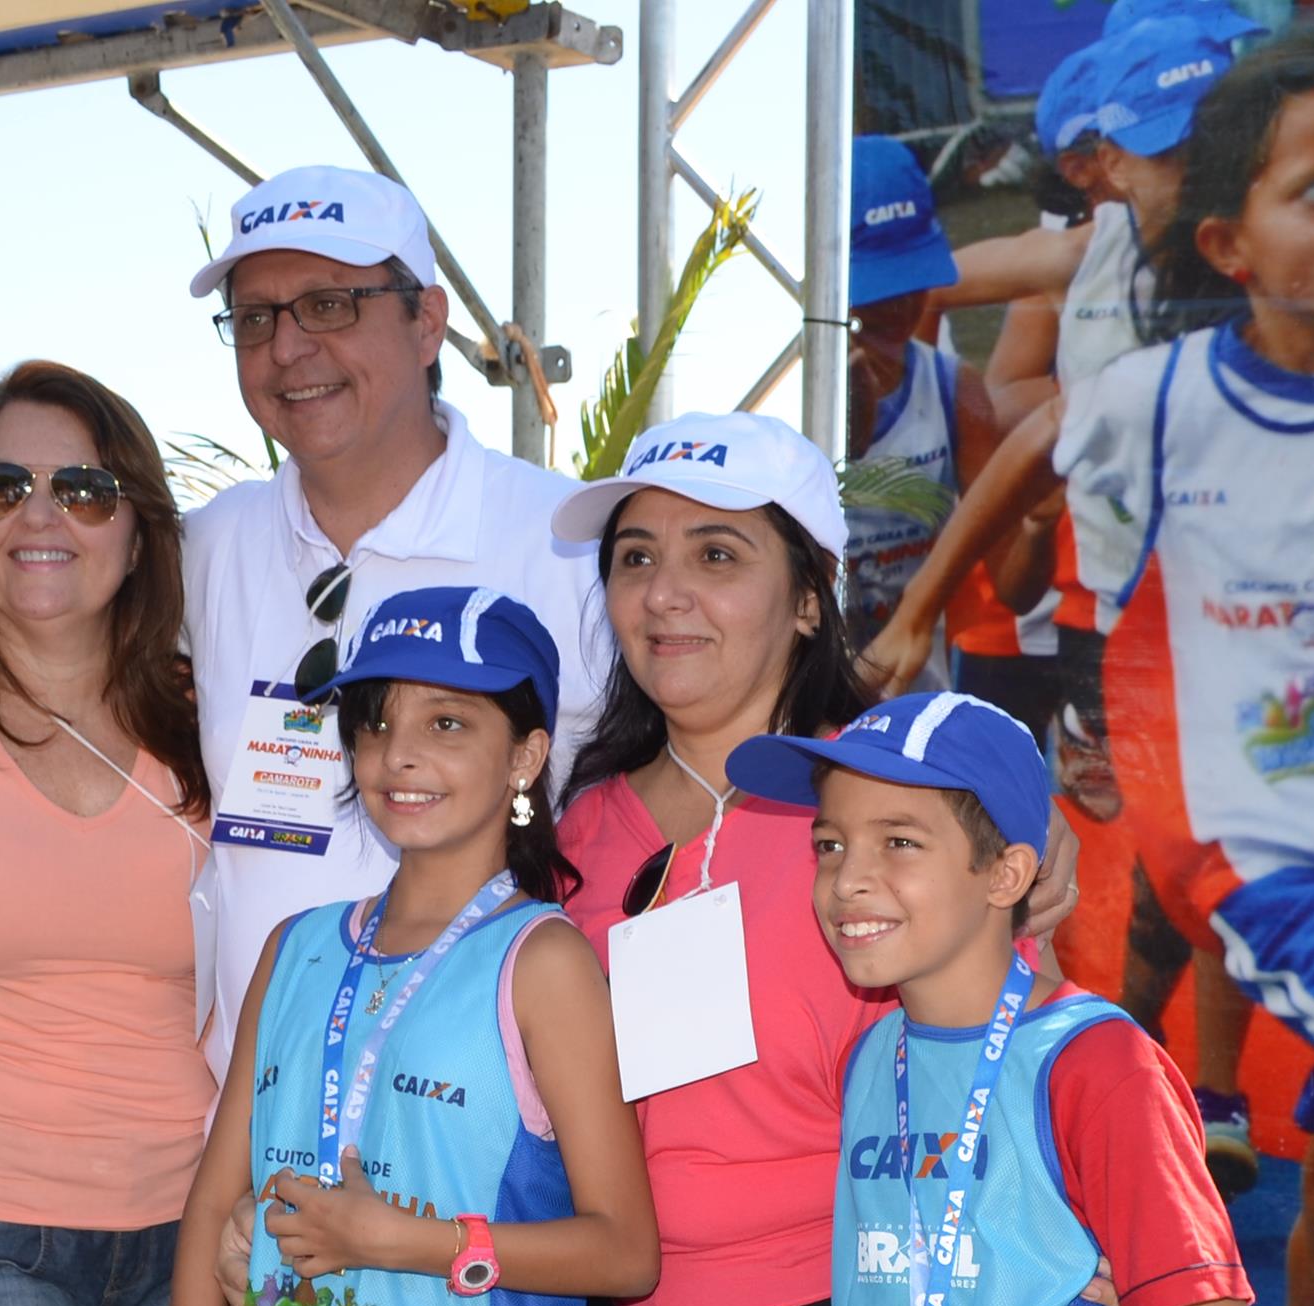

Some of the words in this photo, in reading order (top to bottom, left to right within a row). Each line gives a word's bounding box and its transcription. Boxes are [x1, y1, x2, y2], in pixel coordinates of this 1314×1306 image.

[240, 200, 345, 234] CAIXA
[865, 201, 916, 226] CAIXA
[628, 441, 728, 476] CAIXA
[370, 618, 443, 642] CAIXA
[229, 826, 265, 840] CAIXA
[327, 986, 353, 1046] CAIXA
[985, 992, 1023, 1061] CAIXA
[321, 1069, 339, 1139] CAIXA
[392, 1073, 466, 1107] CAIXA
[958, 1088, 990, 1162] CAIXA
[937, 1189, 966, 1265] CAIXA
